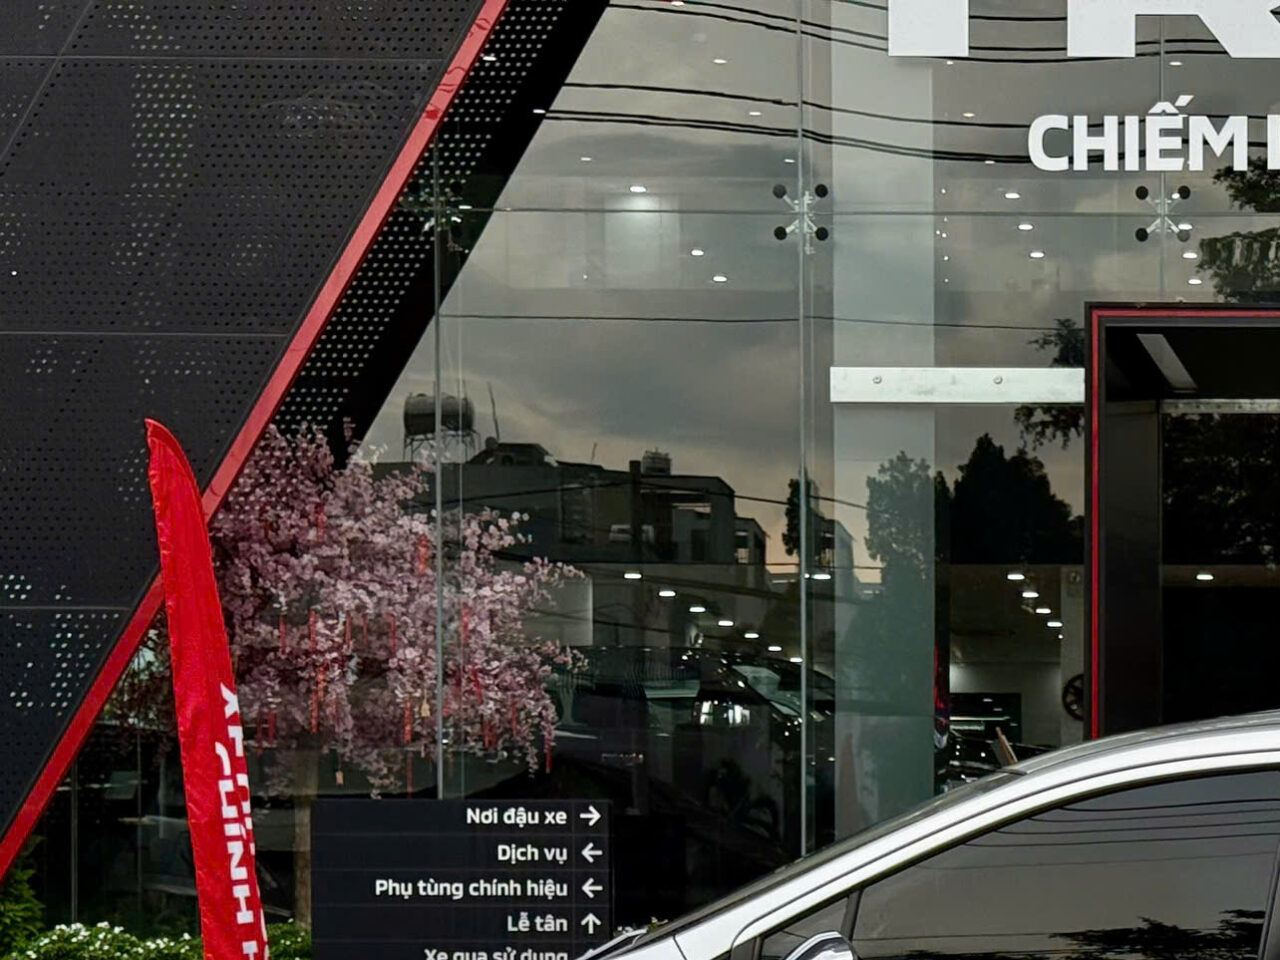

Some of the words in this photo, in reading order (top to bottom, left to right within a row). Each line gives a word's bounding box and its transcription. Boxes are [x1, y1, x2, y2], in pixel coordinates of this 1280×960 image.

[1028, 95, 1248, 171] CHIẾM
[466, 806, 498, 824] Nơi
[503, 806, 539, 828] đậu
[544, 810, 567, 824] xe
[497, 844, 539, 864] Dịch
[544, 848, 567, 864] vụ
[375, 879, 412, 899] Phụ
[418, 879, 463, 900] tùng
[469, 879, 521, 896] chính
[527, 879, 567, 899] hiệu
[507, 912, 530, 932] Lễ
[535, 915, 567, 931] tân
